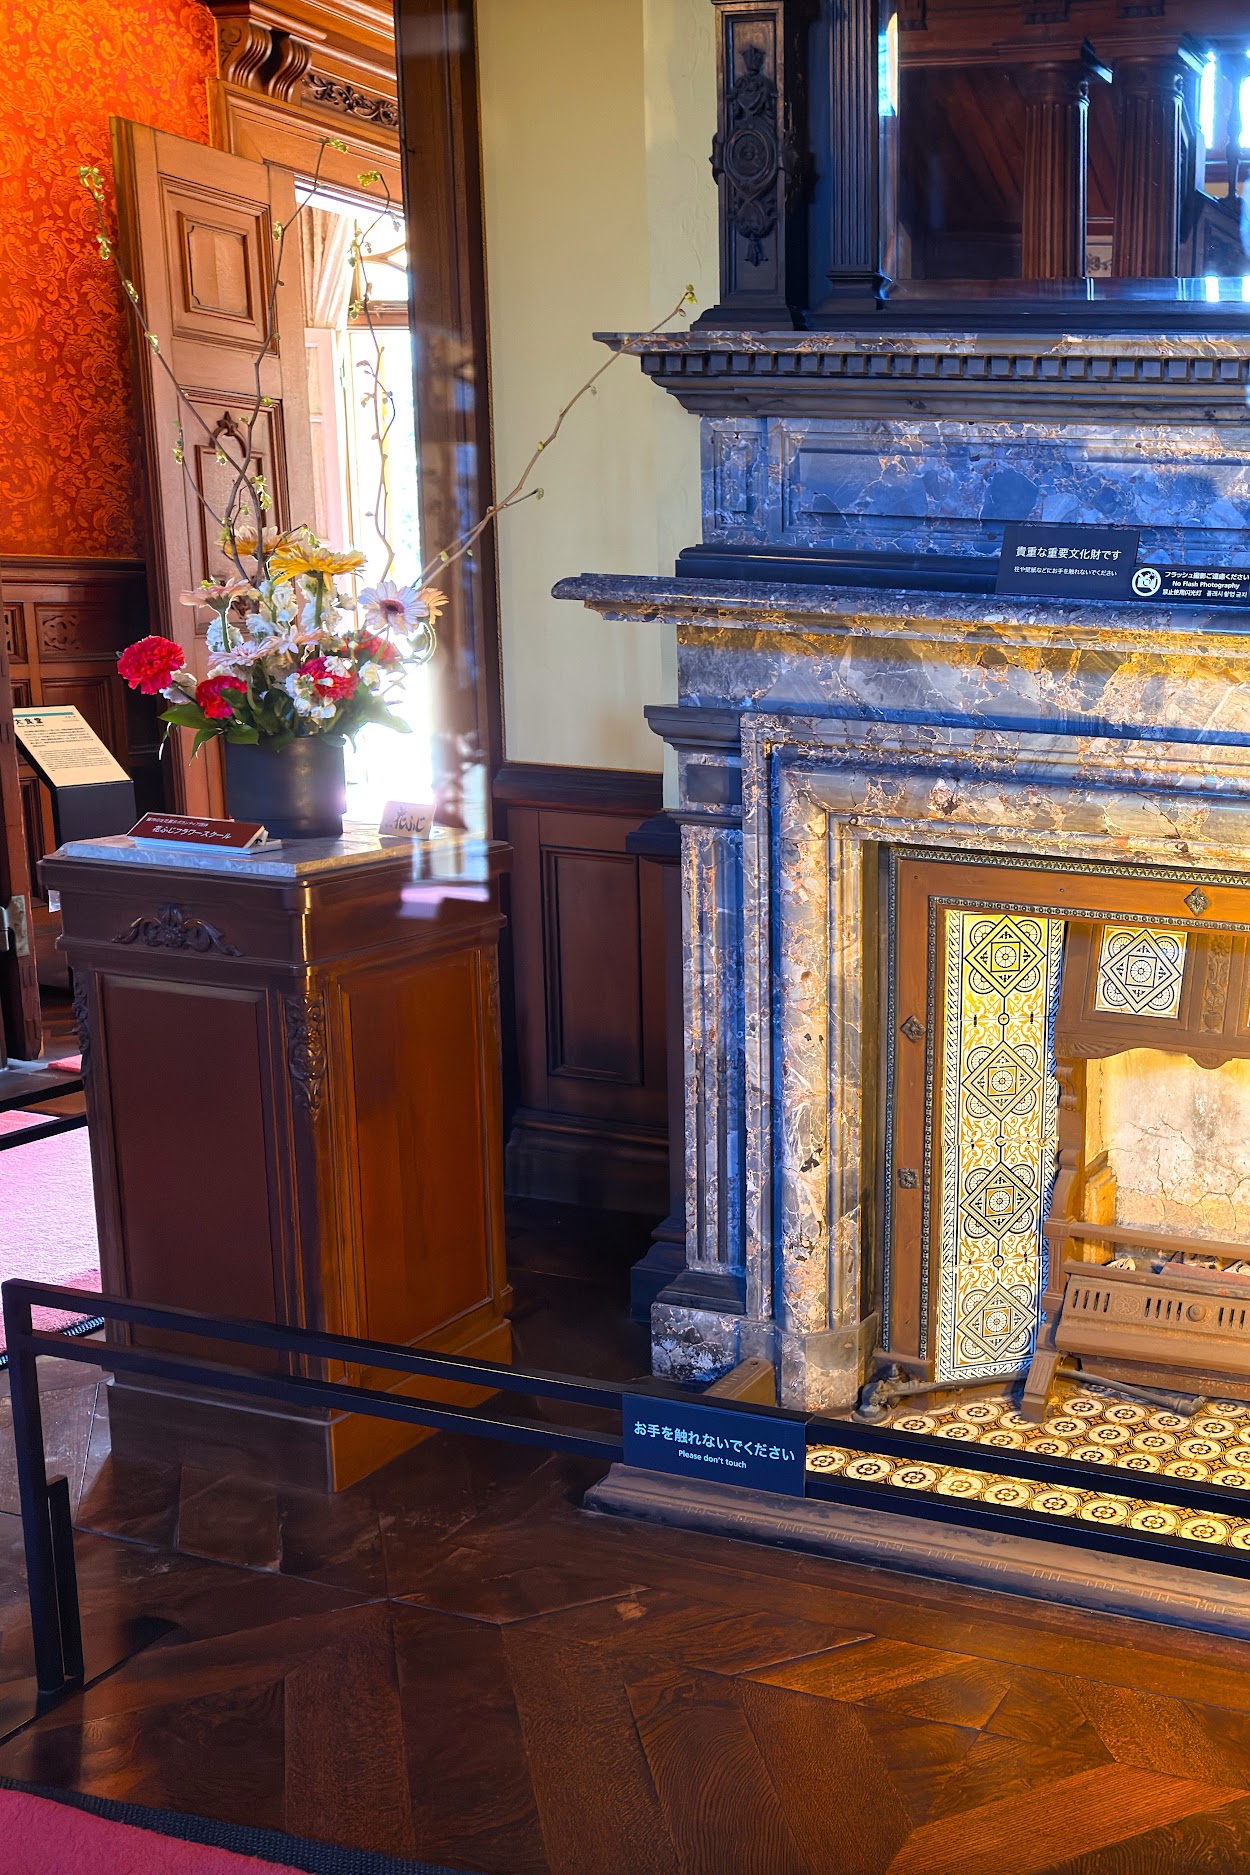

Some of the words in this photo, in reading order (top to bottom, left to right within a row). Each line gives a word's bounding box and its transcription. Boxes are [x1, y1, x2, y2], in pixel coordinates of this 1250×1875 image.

[1015, 546, 1122, 561] 貴重な重要文化財です
[1182, 580, 1198, 588] Flash
[1199, 581, 1240, 590] Photography
[634, 1421, 796, 1461] お手を触れないでください
[678, 1449, 702, 1461] Please
[703, 1453, 724, 1466] don't
[725, 1457, 748, 1469] touch
